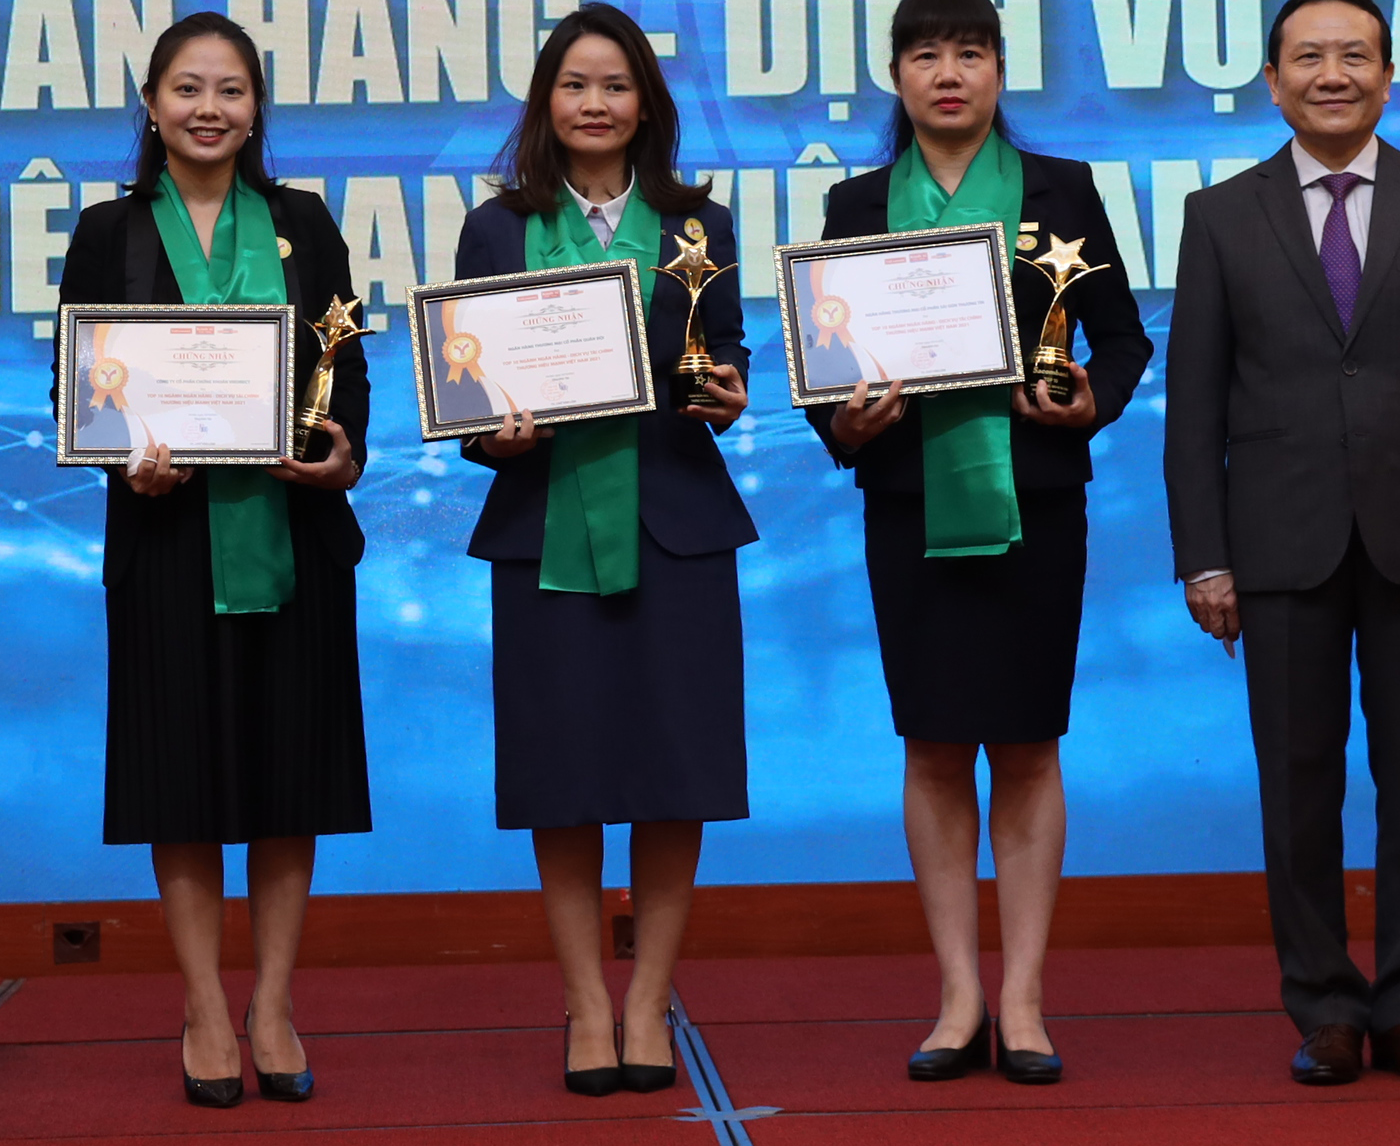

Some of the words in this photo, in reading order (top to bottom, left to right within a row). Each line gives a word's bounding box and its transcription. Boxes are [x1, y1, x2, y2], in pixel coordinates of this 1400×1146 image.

[887, 279, 924, 290] CHỨNG
[926, 276, 955, 288] NHẬN
[522, 314, 554, 325] CHỨNG
[557, 311, 583, 323] NHẬN
[173, 351, 205, 359] CHỨNG
[209, 352, 234, 361] NHẬN
